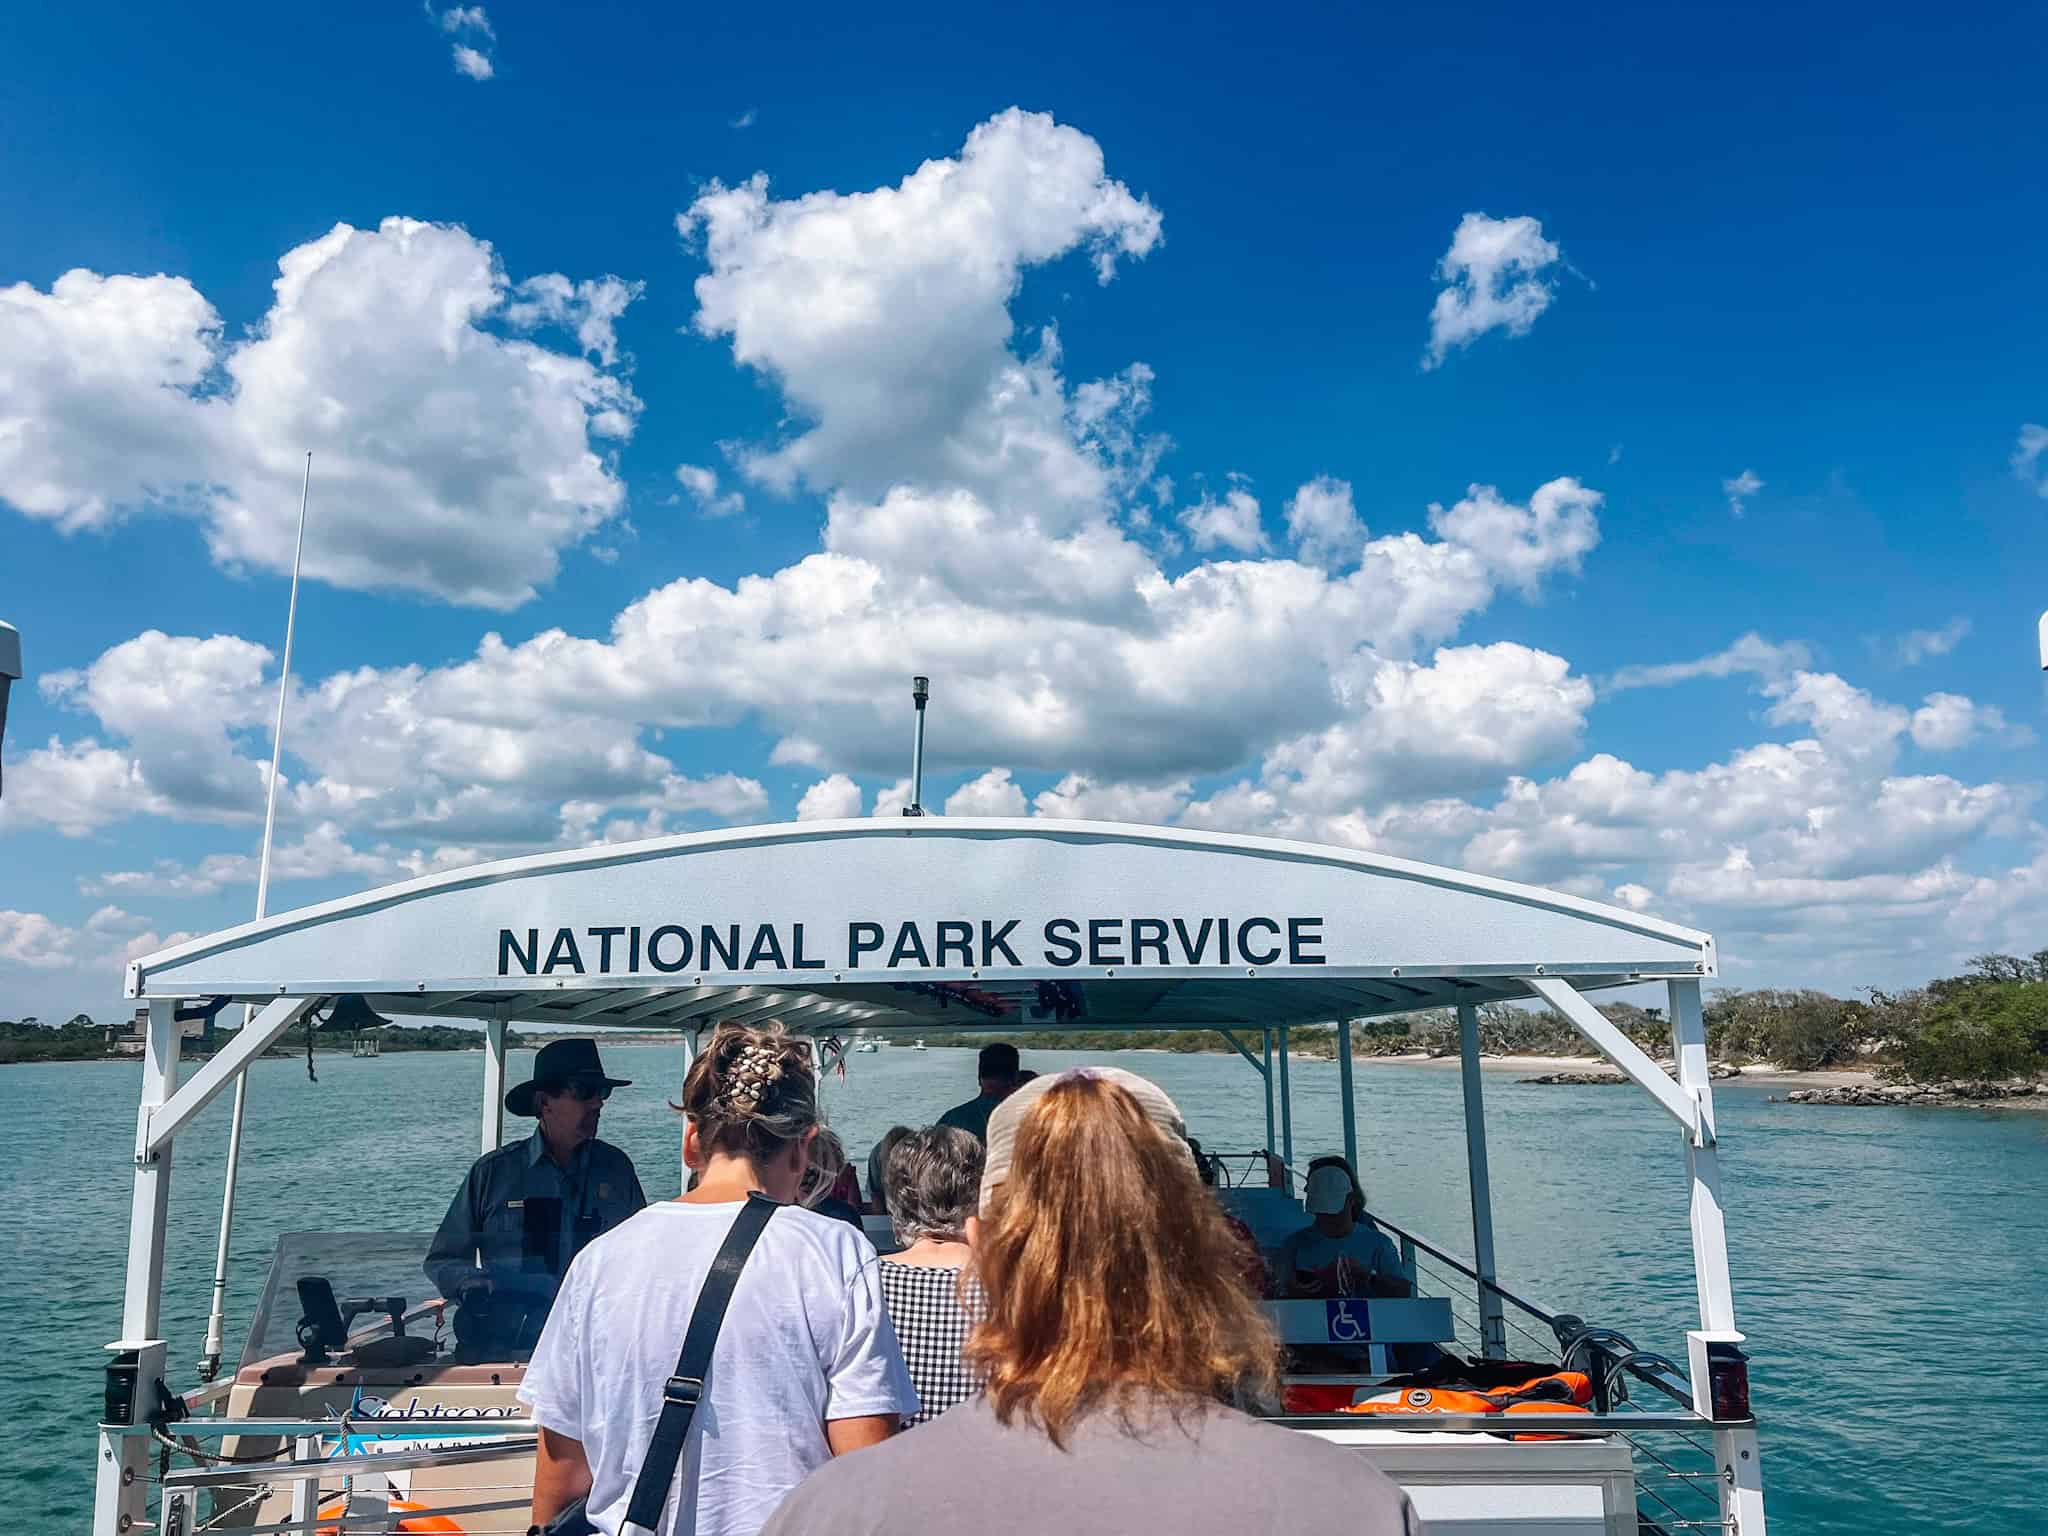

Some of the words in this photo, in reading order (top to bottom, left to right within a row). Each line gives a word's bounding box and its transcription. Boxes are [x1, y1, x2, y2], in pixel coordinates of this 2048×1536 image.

[497, 923, 826, 976] NATIONAL
[848, 918, 1023, 969] PARK
[1043, 916, 1327, 967] SERVICE
